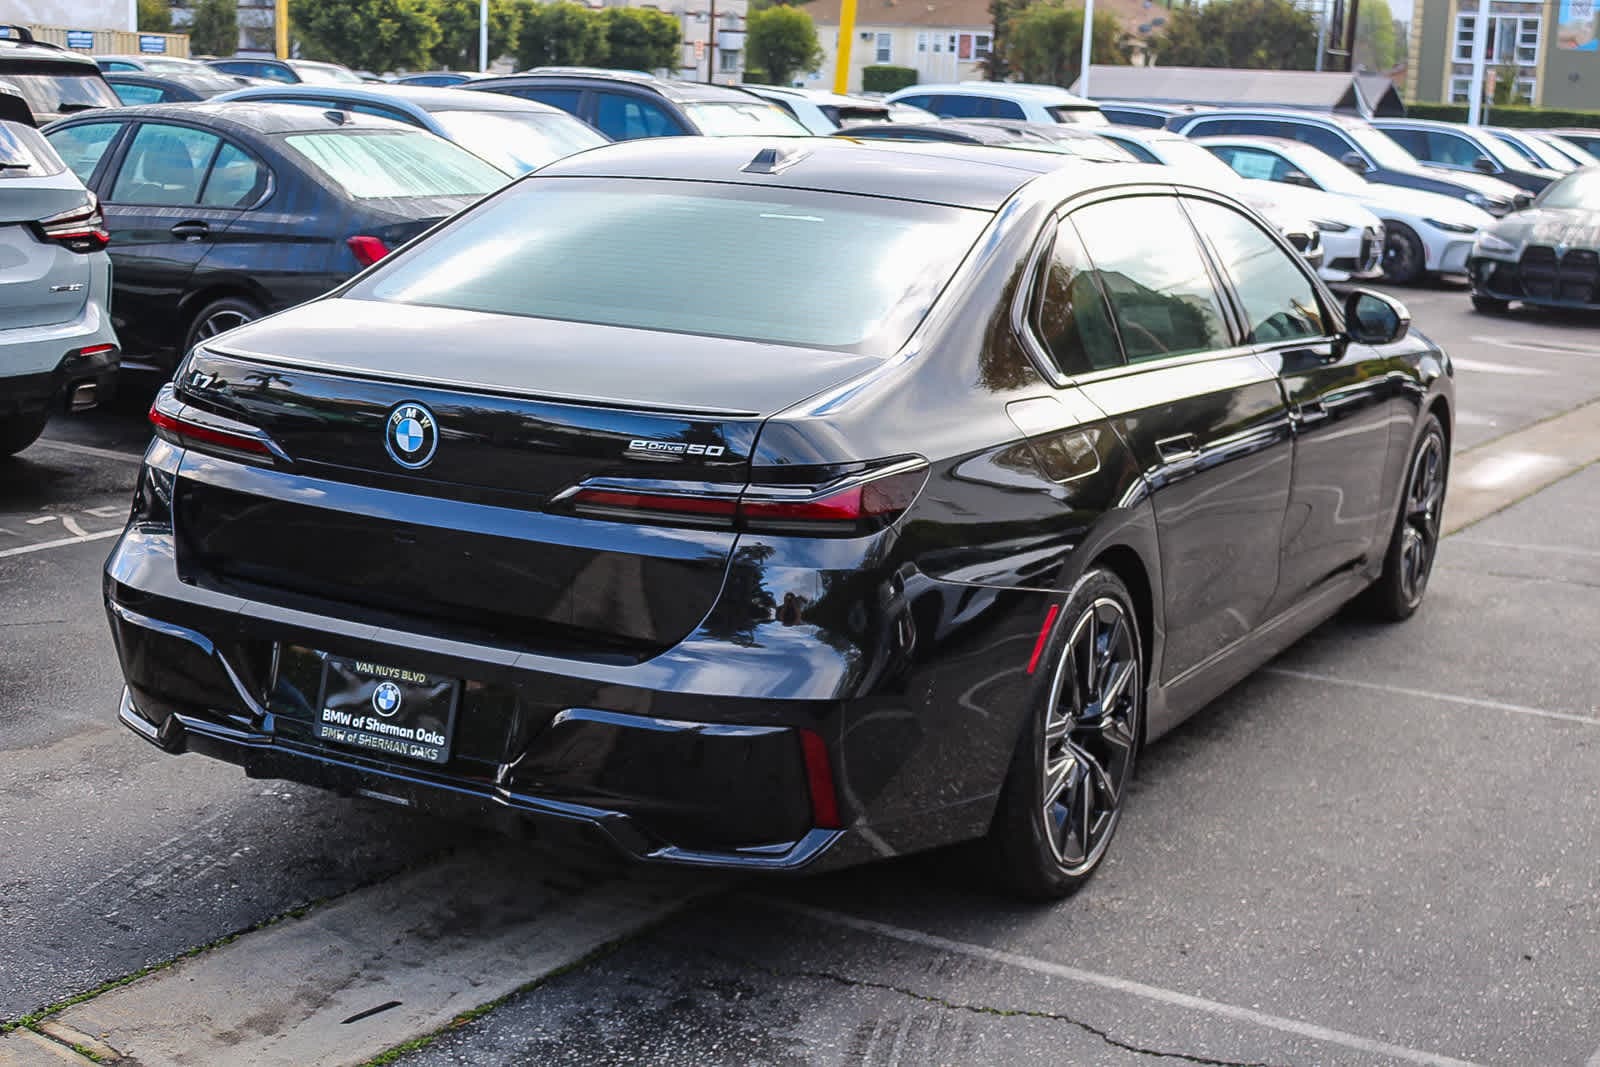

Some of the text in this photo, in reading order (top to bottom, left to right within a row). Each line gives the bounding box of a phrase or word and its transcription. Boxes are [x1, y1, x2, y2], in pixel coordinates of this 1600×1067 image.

[392, 407, 432, 429] BMW
[356, 661, 426, 683] VAN NUYS BLVD
[322, 709, 445, 745] BMW of Sherman Oaks
[321, 727, 438, 760] BMW of SHERMAN OAKS
